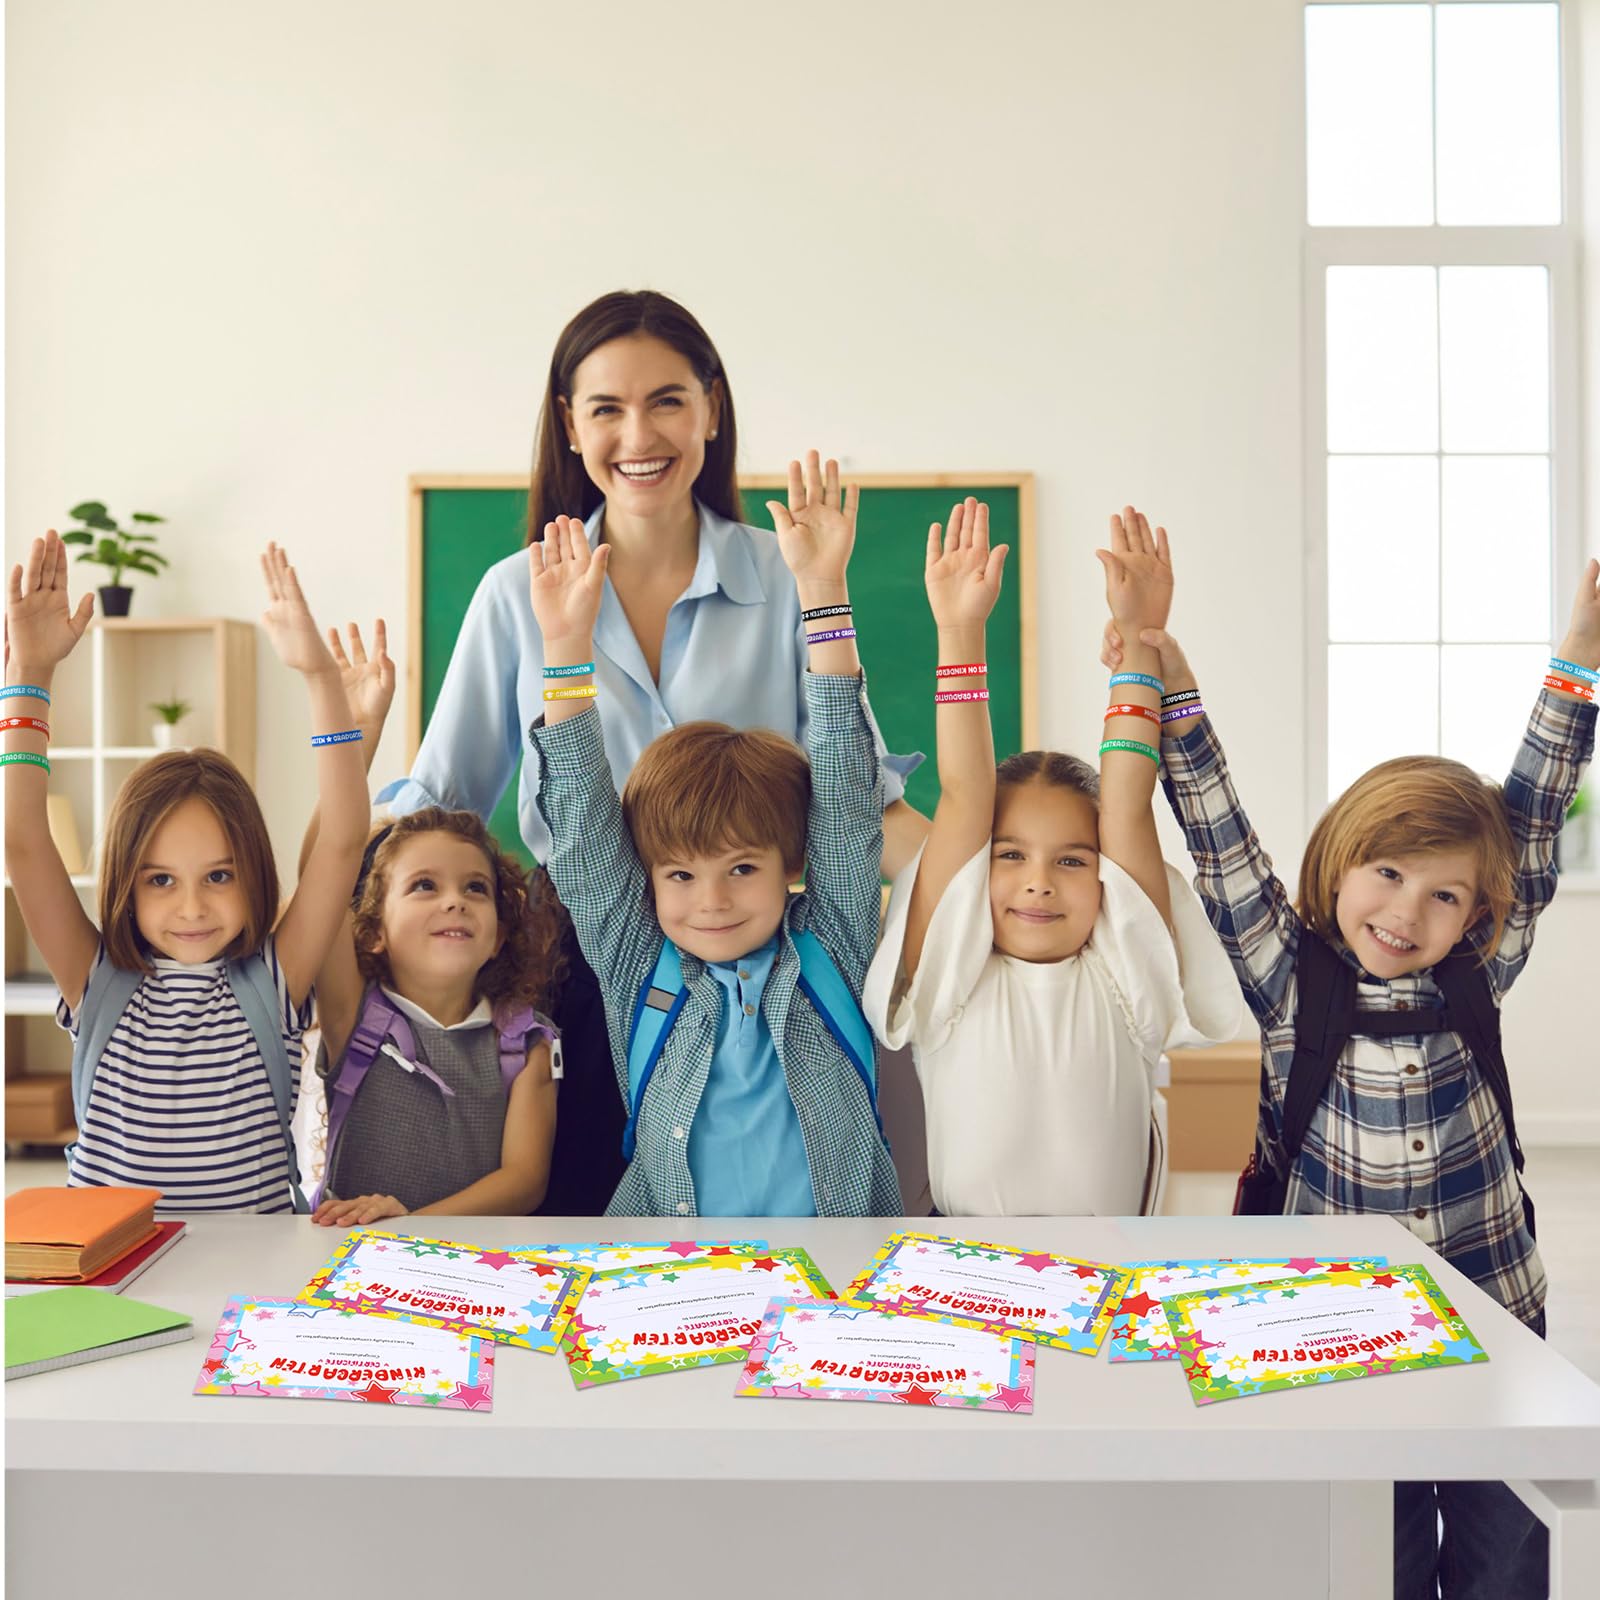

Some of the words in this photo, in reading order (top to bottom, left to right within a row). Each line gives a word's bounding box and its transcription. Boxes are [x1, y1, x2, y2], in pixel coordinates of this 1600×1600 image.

[366, 1283, 505, 1316] KINDERGARTEN
[416, 1289, 466, 1303] CERTIFICATE
[907, 1285, 1046, 1319] KINDERGARTEN
[957, 1291, 1007, 1305] CERTIFICATE
[684, 1317, 739, 1331] CERTIFICATE
[1252, 1329, 1408, 1362] KINDERGARTEN
[1303, 1334, 1359, 1348] CERTIFICATE
[269, 1357, 426, 1382] KINDERGARTEN
[325, 1359, 380, 1368] CERTIFICATE
[866, 1360, 922, 1370] CERTIFICATE
[810, 1360, 966, 1383] KINDERGARTEN
